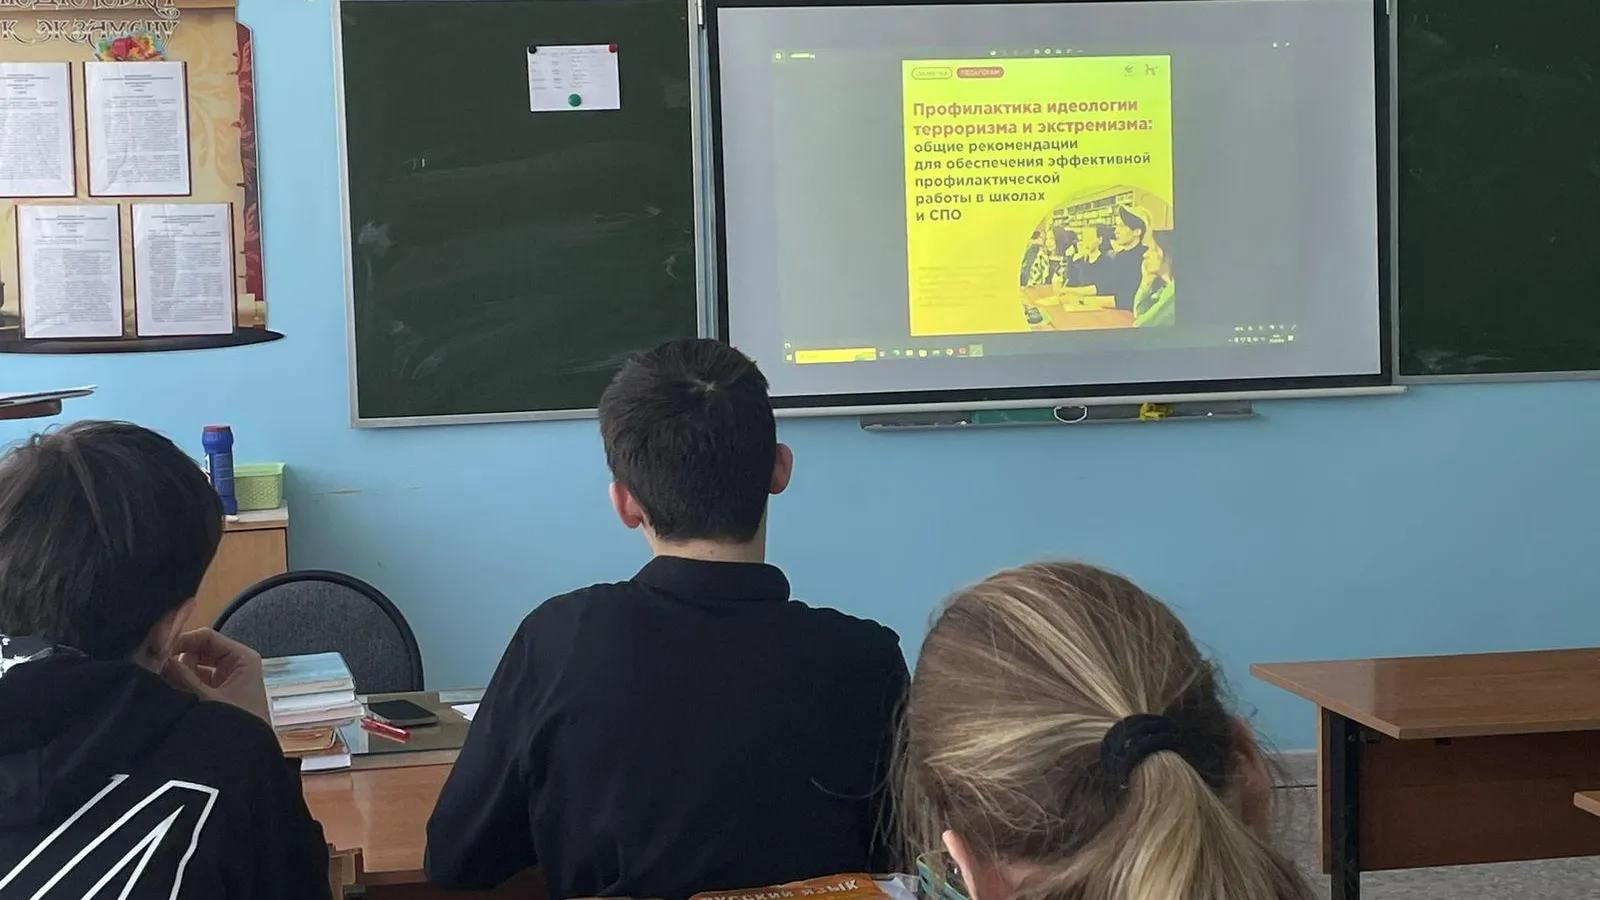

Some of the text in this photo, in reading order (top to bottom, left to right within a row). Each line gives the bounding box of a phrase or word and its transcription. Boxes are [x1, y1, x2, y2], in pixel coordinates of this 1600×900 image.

[913, 100, 1138, 119] Профилактика идеологии
[913, 119, 1153, 138] терроризма и экстремизма:
[914, 140, 1078, 154] общие рекомендации
[914, 152, 1151, 171] для обеспечения эффективной
[915, 172, 1060, 188] профилактической
[916, 191, 1045, 206] работы в школах
[916, 208, 962, 221] и СПО
